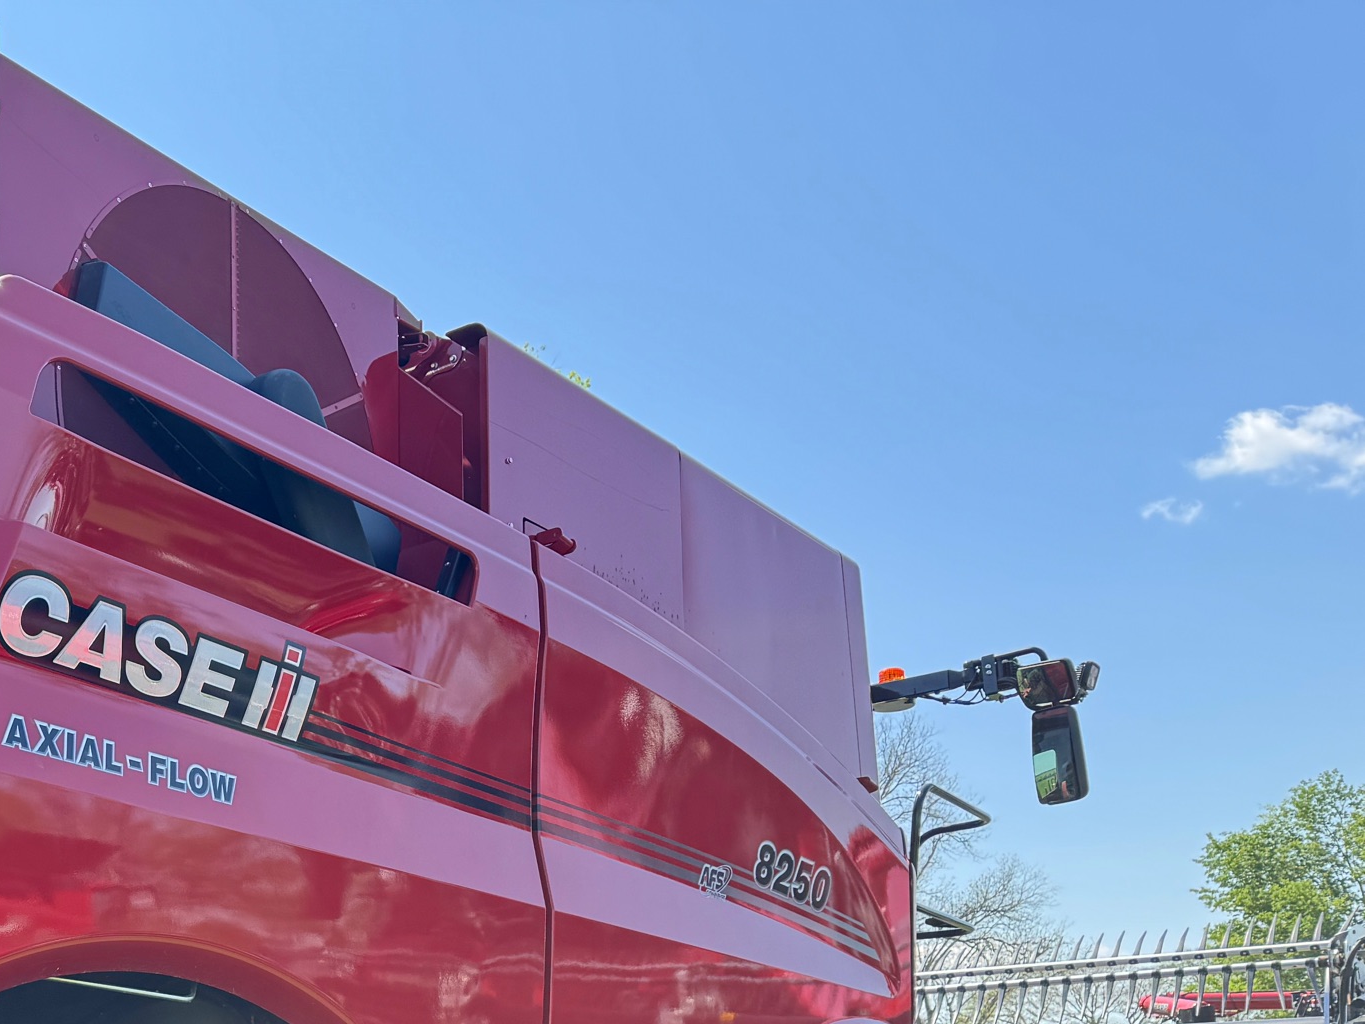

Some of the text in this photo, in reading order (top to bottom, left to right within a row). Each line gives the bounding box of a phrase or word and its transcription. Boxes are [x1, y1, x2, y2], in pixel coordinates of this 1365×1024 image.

[1, 713, 237, 805] AXIAL-FLOW
[698, 863, 728, 891] AFS
[753, 840, 832, 912] 8250
